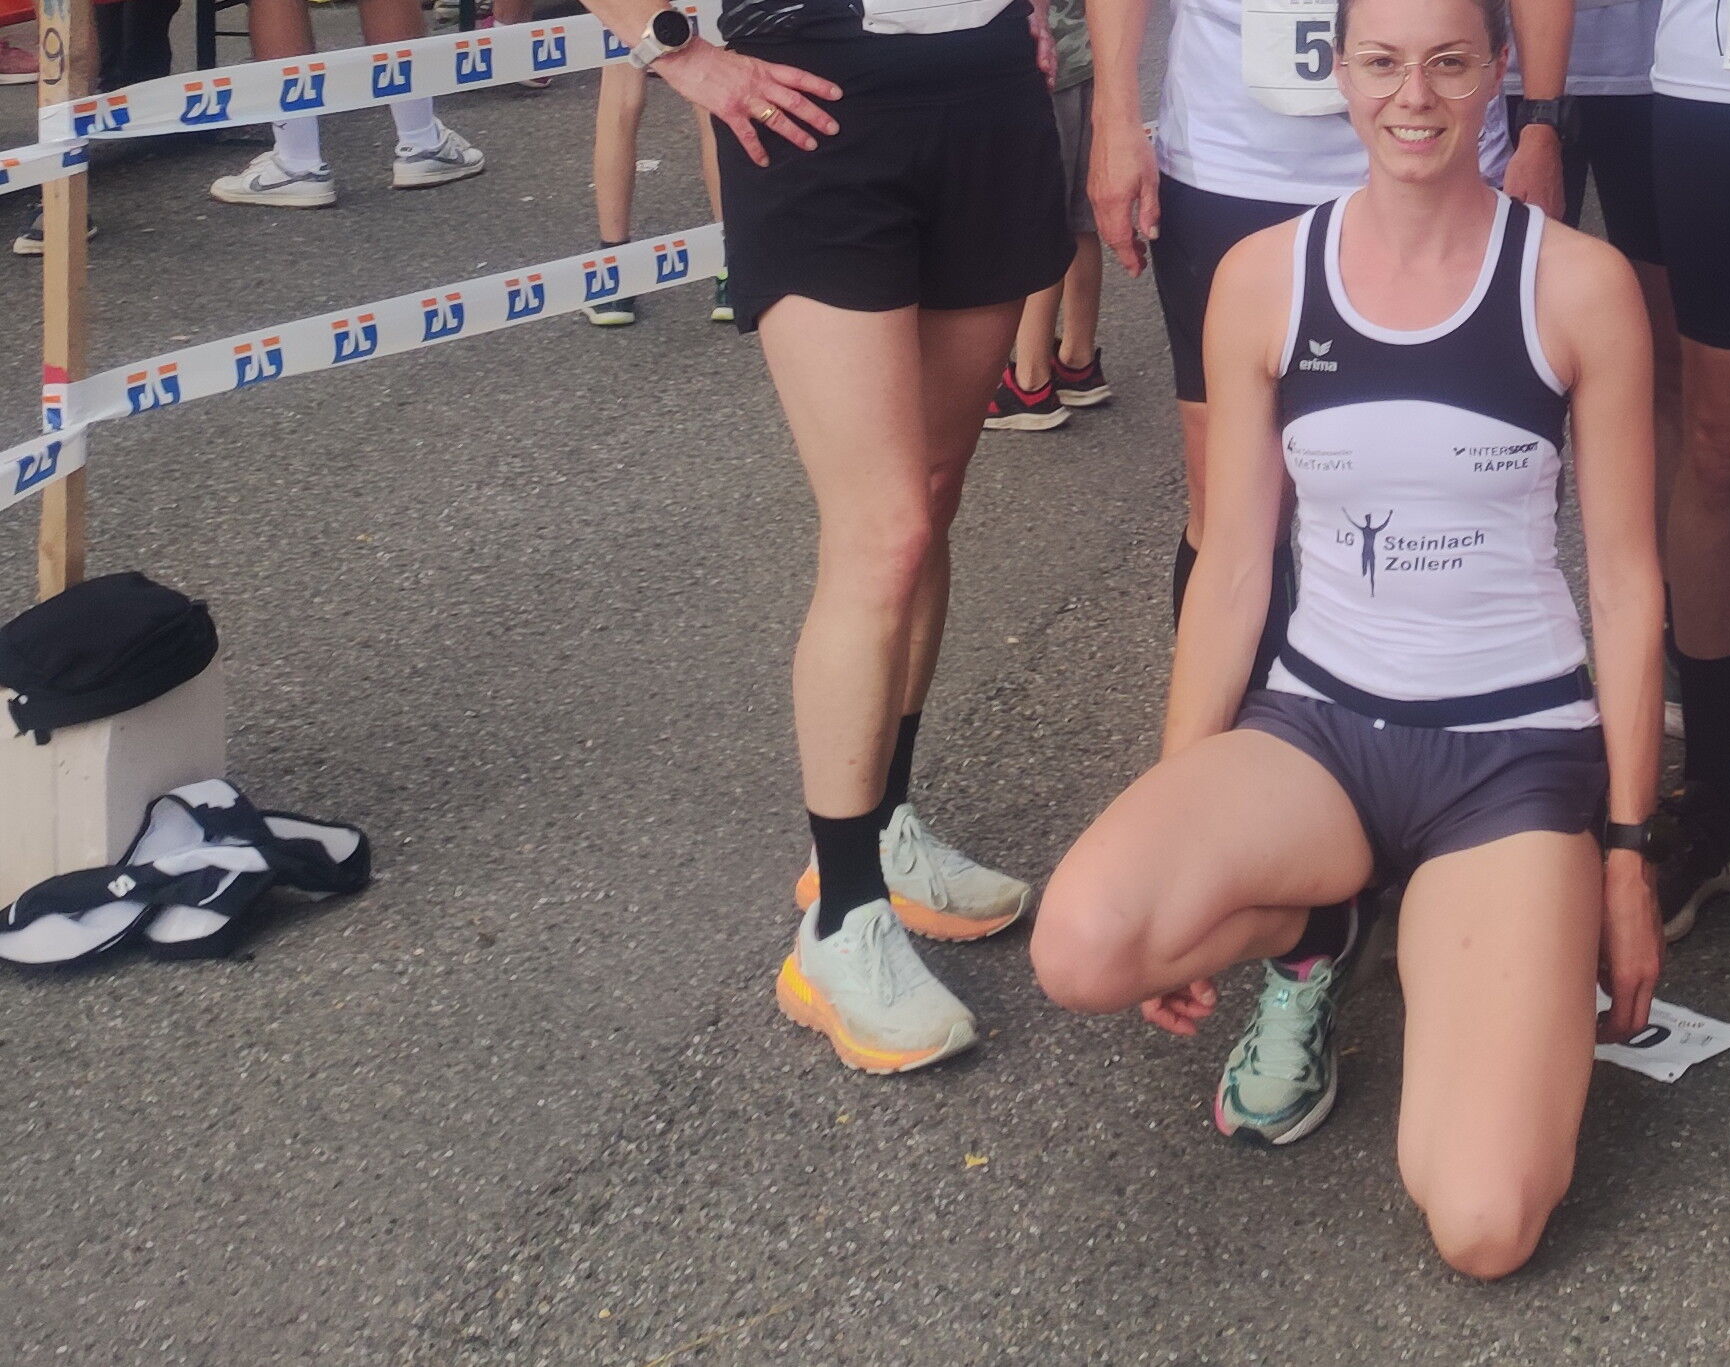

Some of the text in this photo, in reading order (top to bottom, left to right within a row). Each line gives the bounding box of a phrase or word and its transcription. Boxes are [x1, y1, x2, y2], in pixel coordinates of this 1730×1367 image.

[1300, 358, 1338, 373] erima
[1336, 529, 1485, 551] LG Steinlach
[1384, 557, 1463, 572] Zollern
